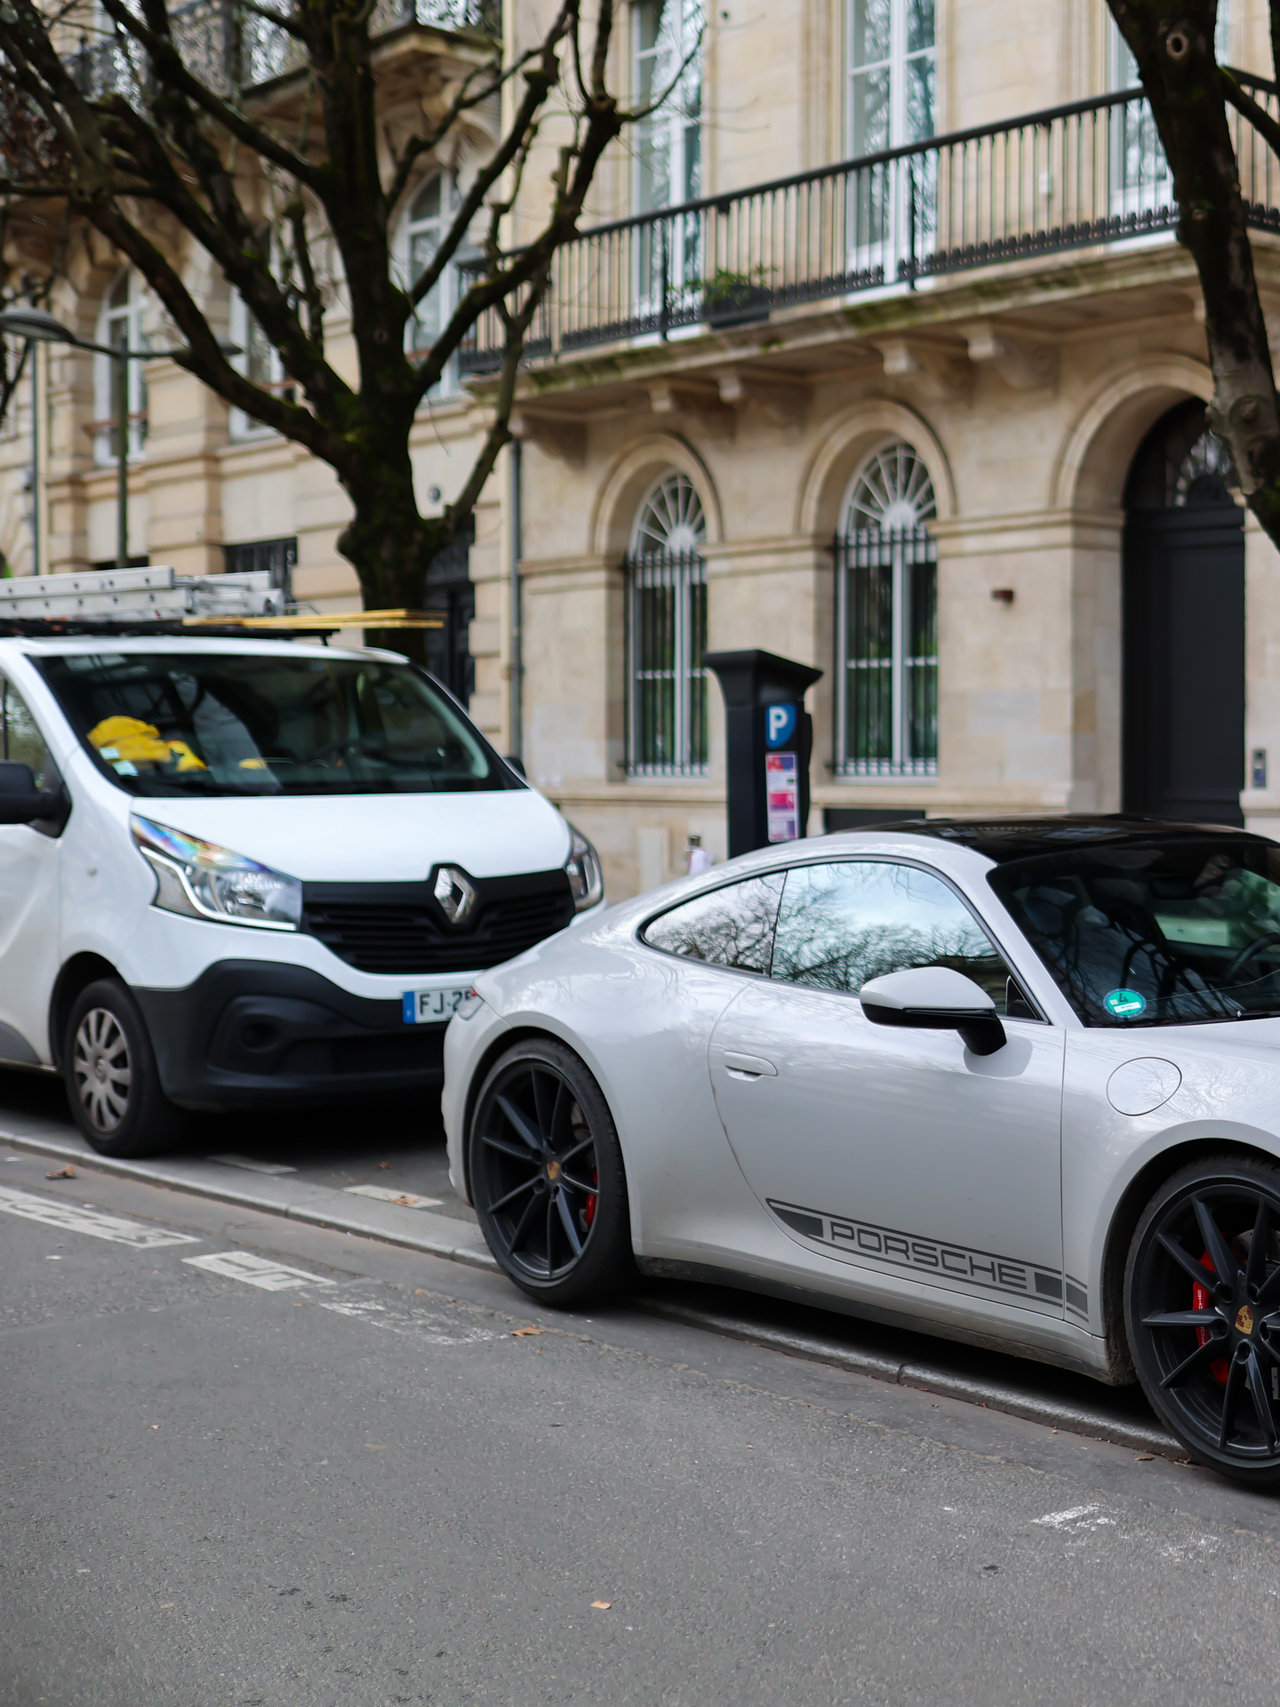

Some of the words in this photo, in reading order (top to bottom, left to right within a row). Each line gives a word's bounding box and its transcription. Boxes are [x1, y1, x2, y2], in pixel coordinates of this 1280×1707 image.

[769, 706, 788, 741] P
[1119, 993, 1129, 1002] 4
[830, 1221, 1027, 1290] PORSCHE
